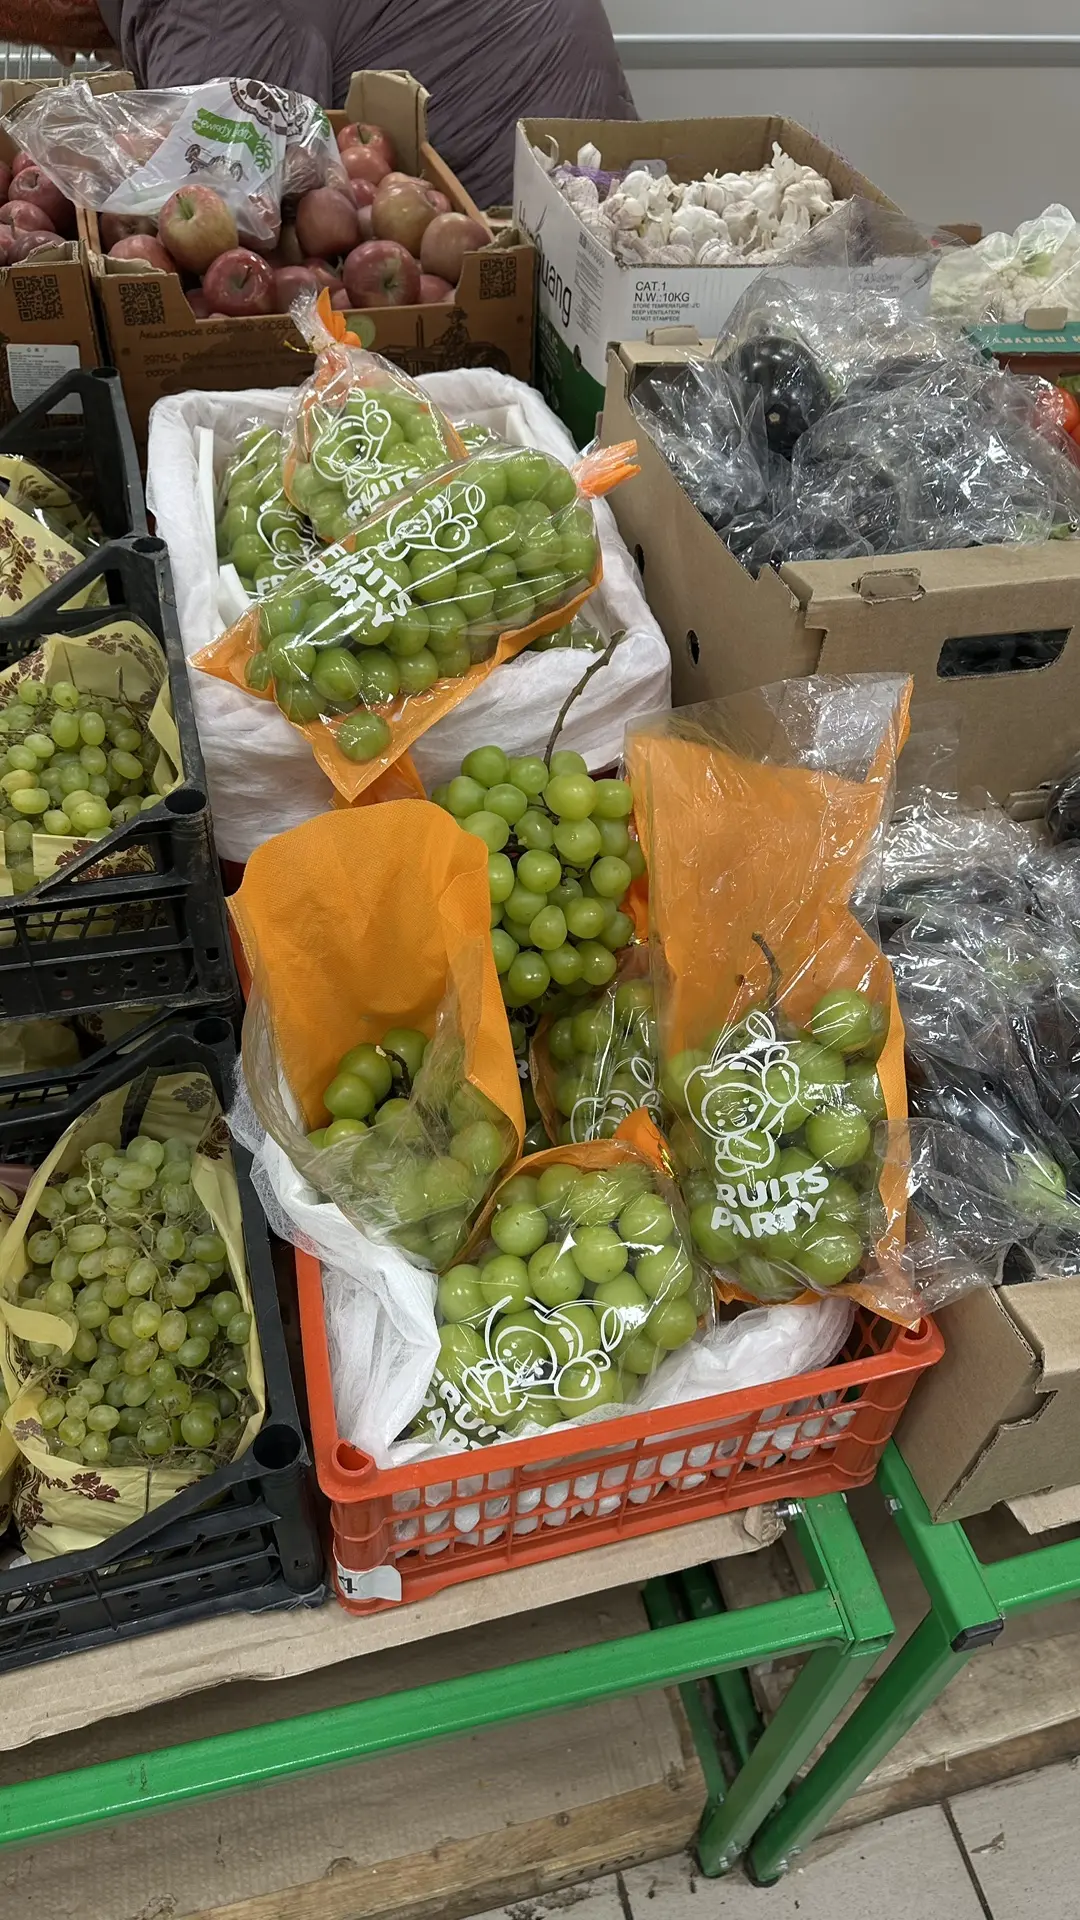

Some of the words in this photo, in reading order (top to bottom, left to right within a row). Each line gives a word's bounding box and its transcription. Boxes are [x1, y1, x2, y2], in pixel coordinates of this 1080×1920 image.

[635, 281, 667, 292] CAT.1
[716, 1166, 830, 1209] RUITS
[710, 1197, 825, 1239] PARTY
